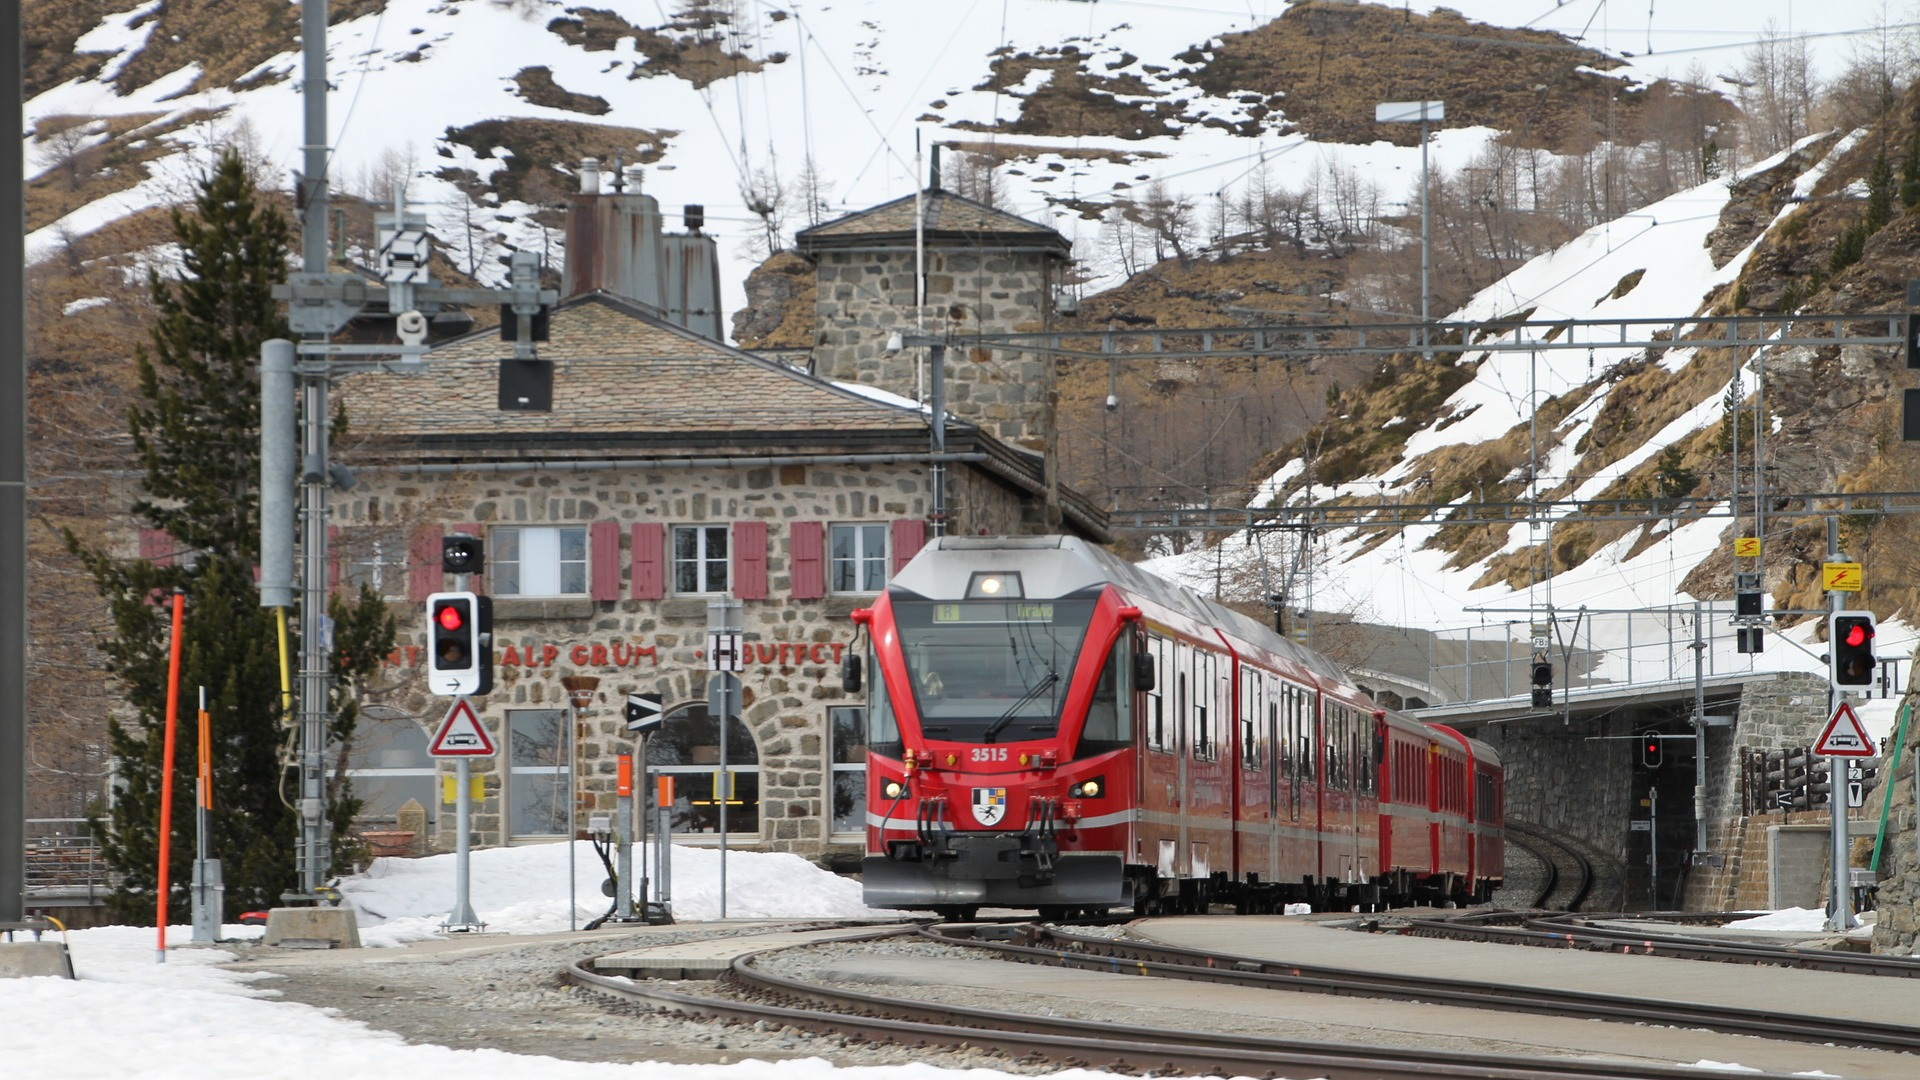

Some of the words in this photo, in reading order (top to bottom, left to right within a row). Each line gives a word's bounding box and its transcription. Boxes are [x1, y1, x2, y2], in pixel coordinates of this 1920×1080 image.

[501, 644, 559, 667] ALP
[743, 643, 845, 664] BUFFET
[971, 747, 1008, 762] 3515
[1852, 768, 1859, 779] 2
